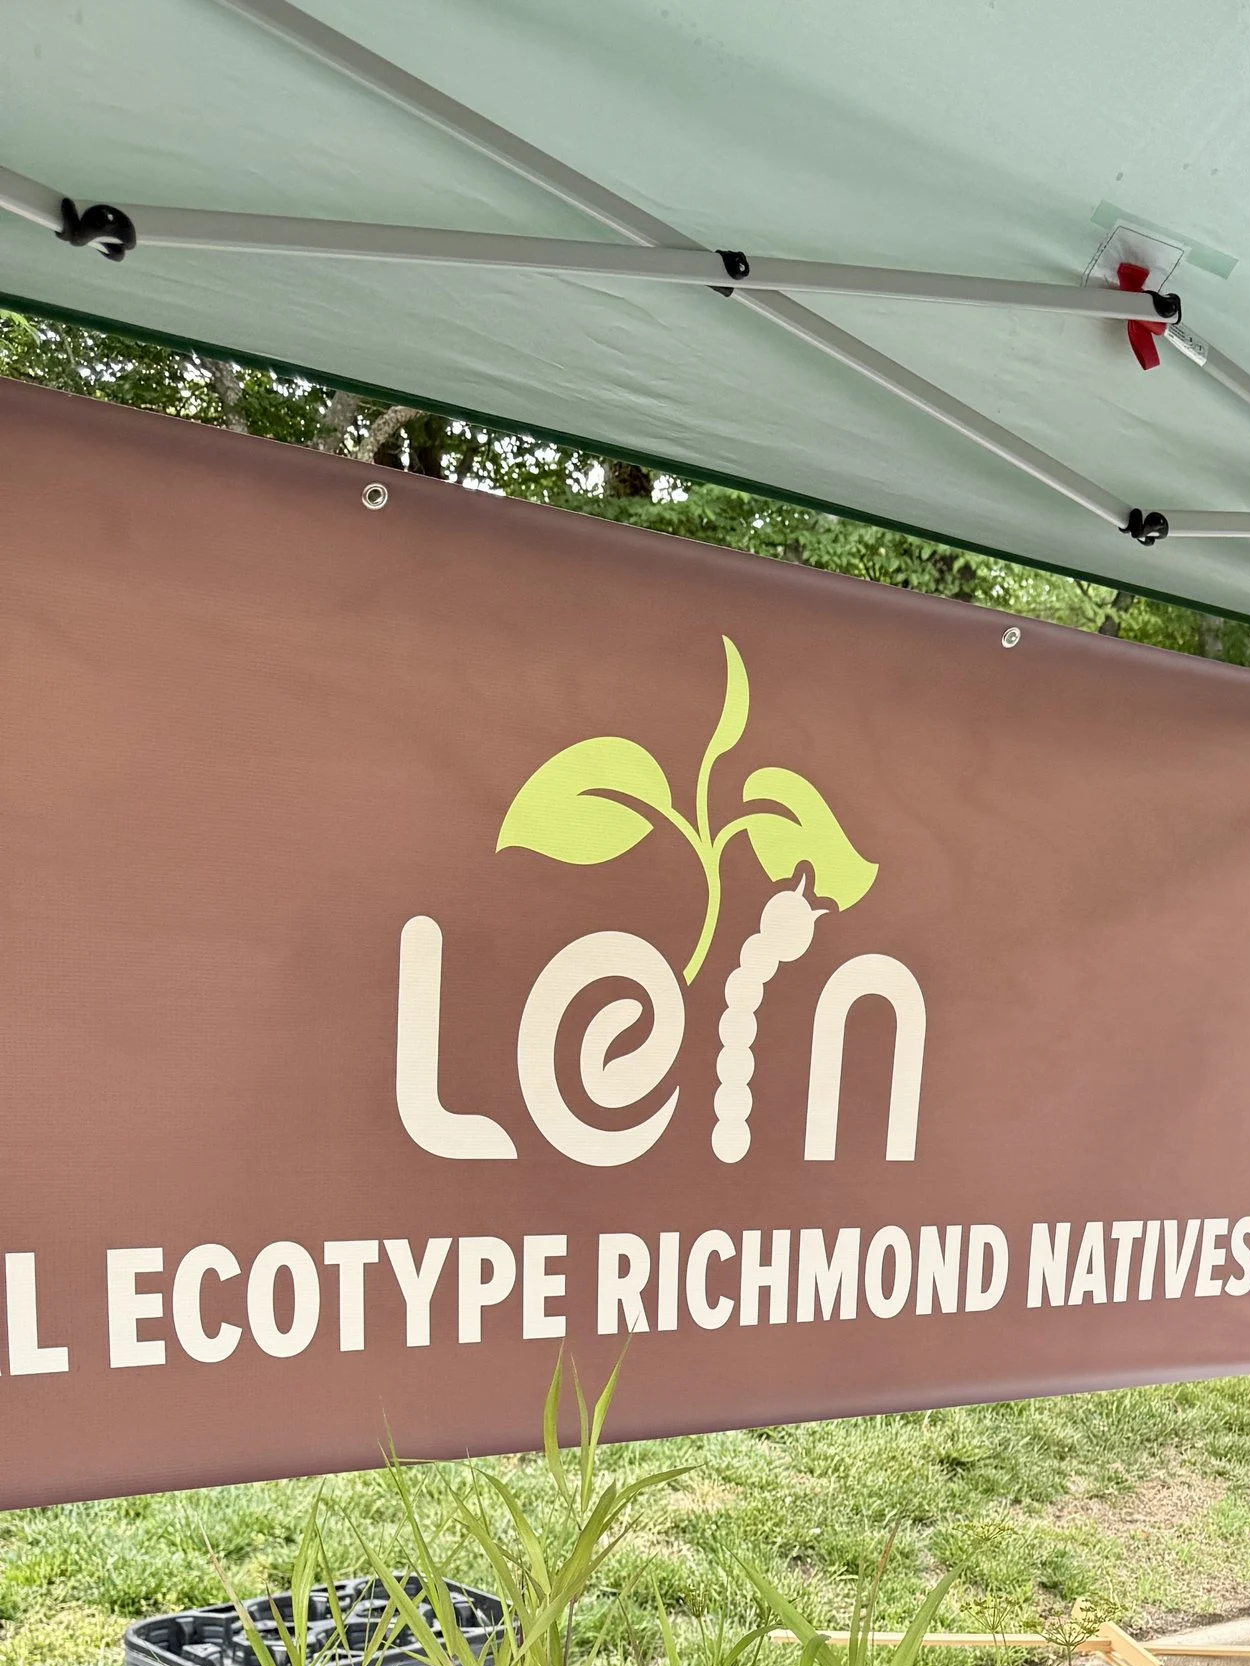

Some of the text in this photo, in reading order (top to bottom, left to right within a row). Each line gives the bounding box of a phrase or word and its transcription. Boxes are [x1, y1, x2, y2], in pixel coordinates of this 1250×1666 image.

[0, 1252, 69, 1376] L
[106, 1234, 567, 1369] ECOTYPE
[597, 1225, 1009, 1336] RICHMOND
